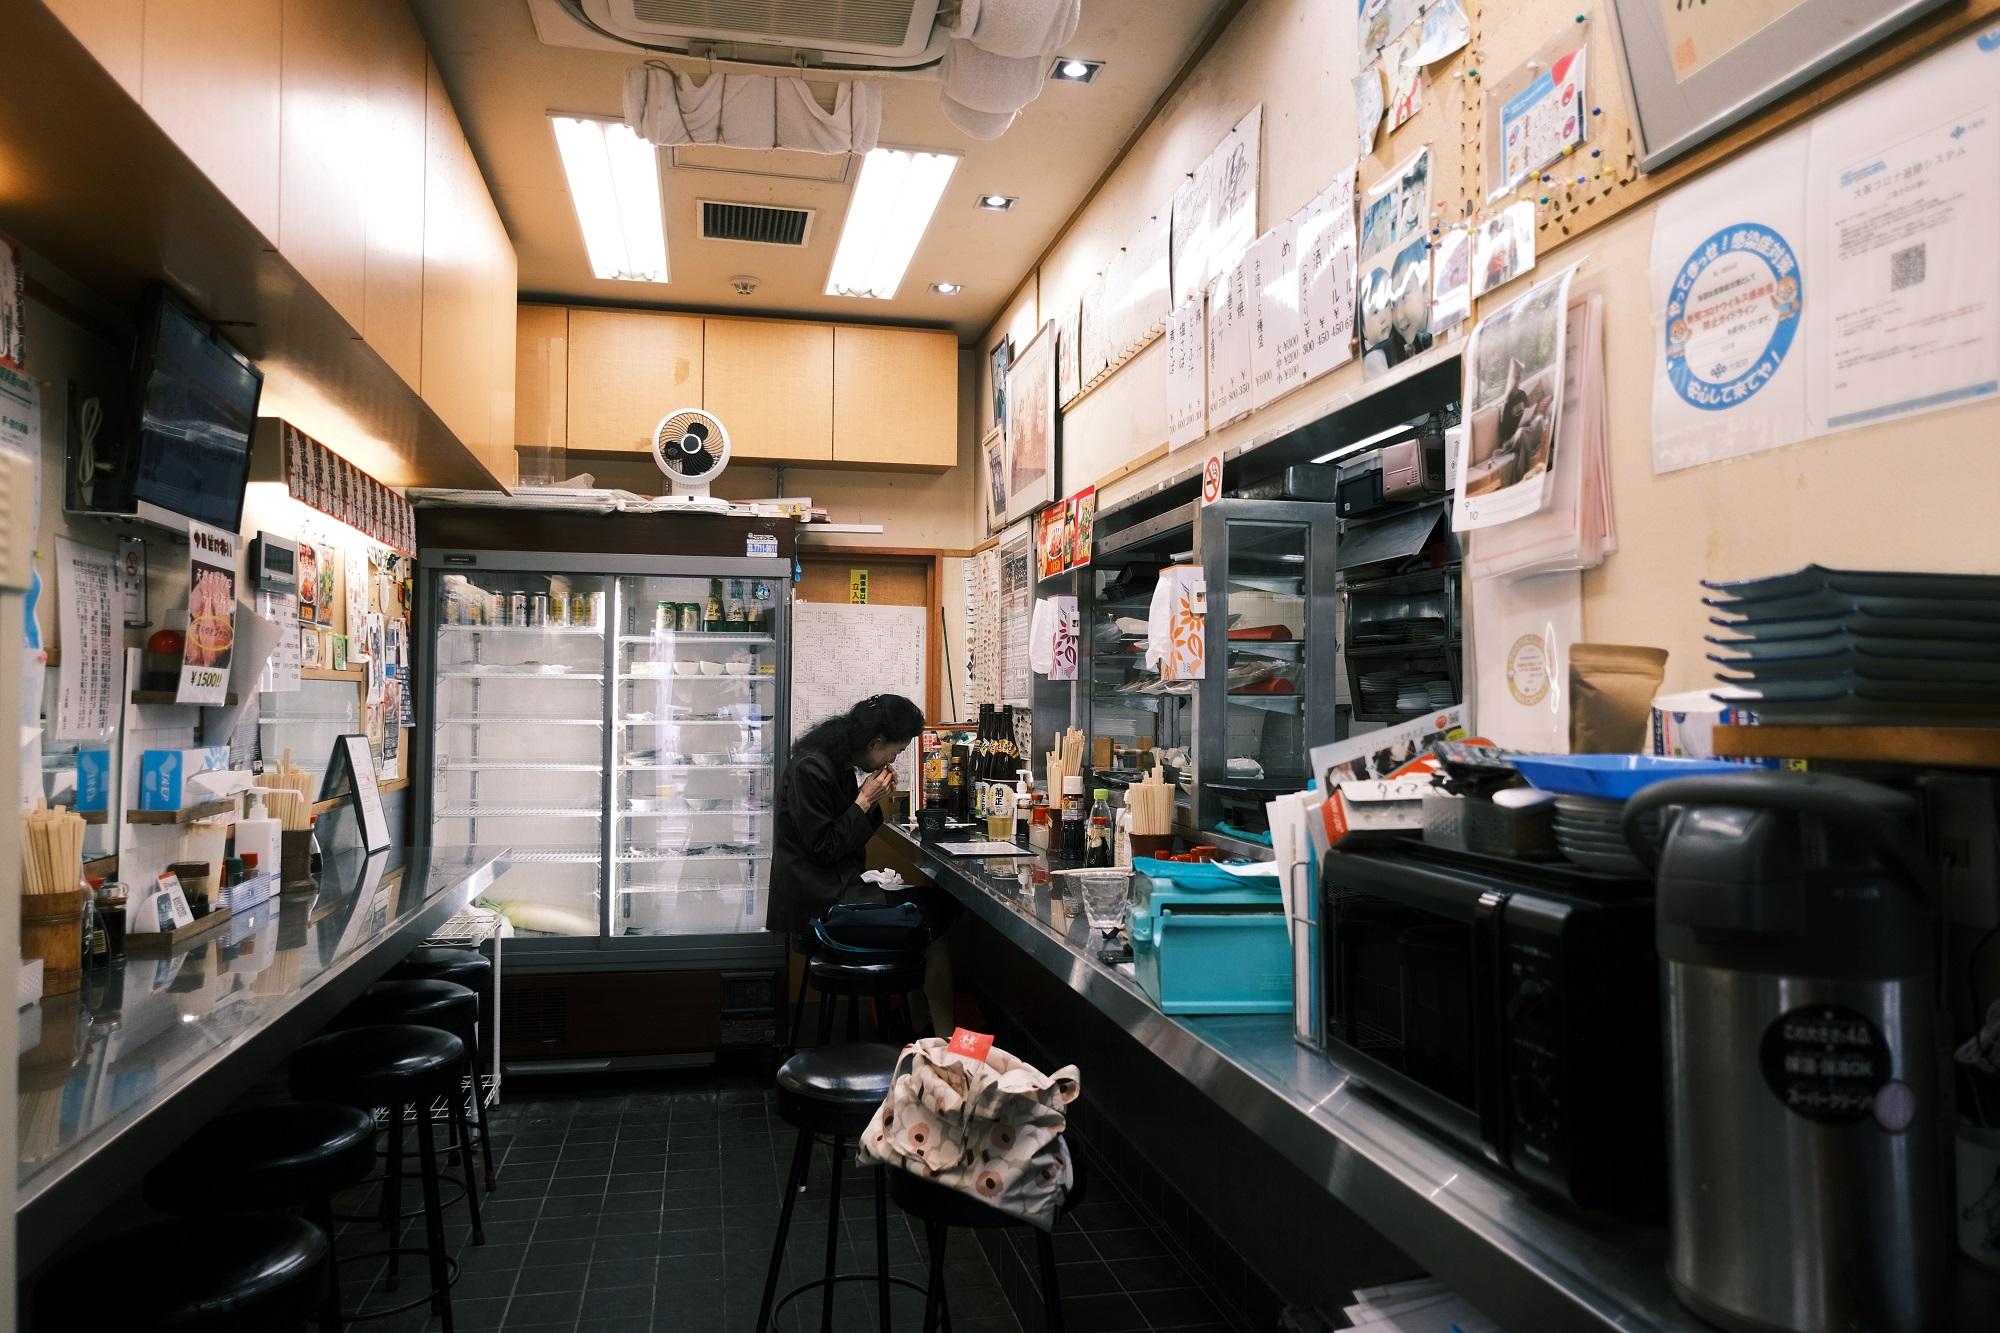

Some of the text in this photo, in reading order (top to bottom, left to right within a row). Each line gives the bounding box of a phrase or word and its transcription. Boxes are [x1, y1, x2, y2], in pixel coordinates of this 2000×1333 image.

[1854, 146, 1967, 199] 大阪コロナ追跡システム
[190, 670, 223, 688] ¥1500!!
